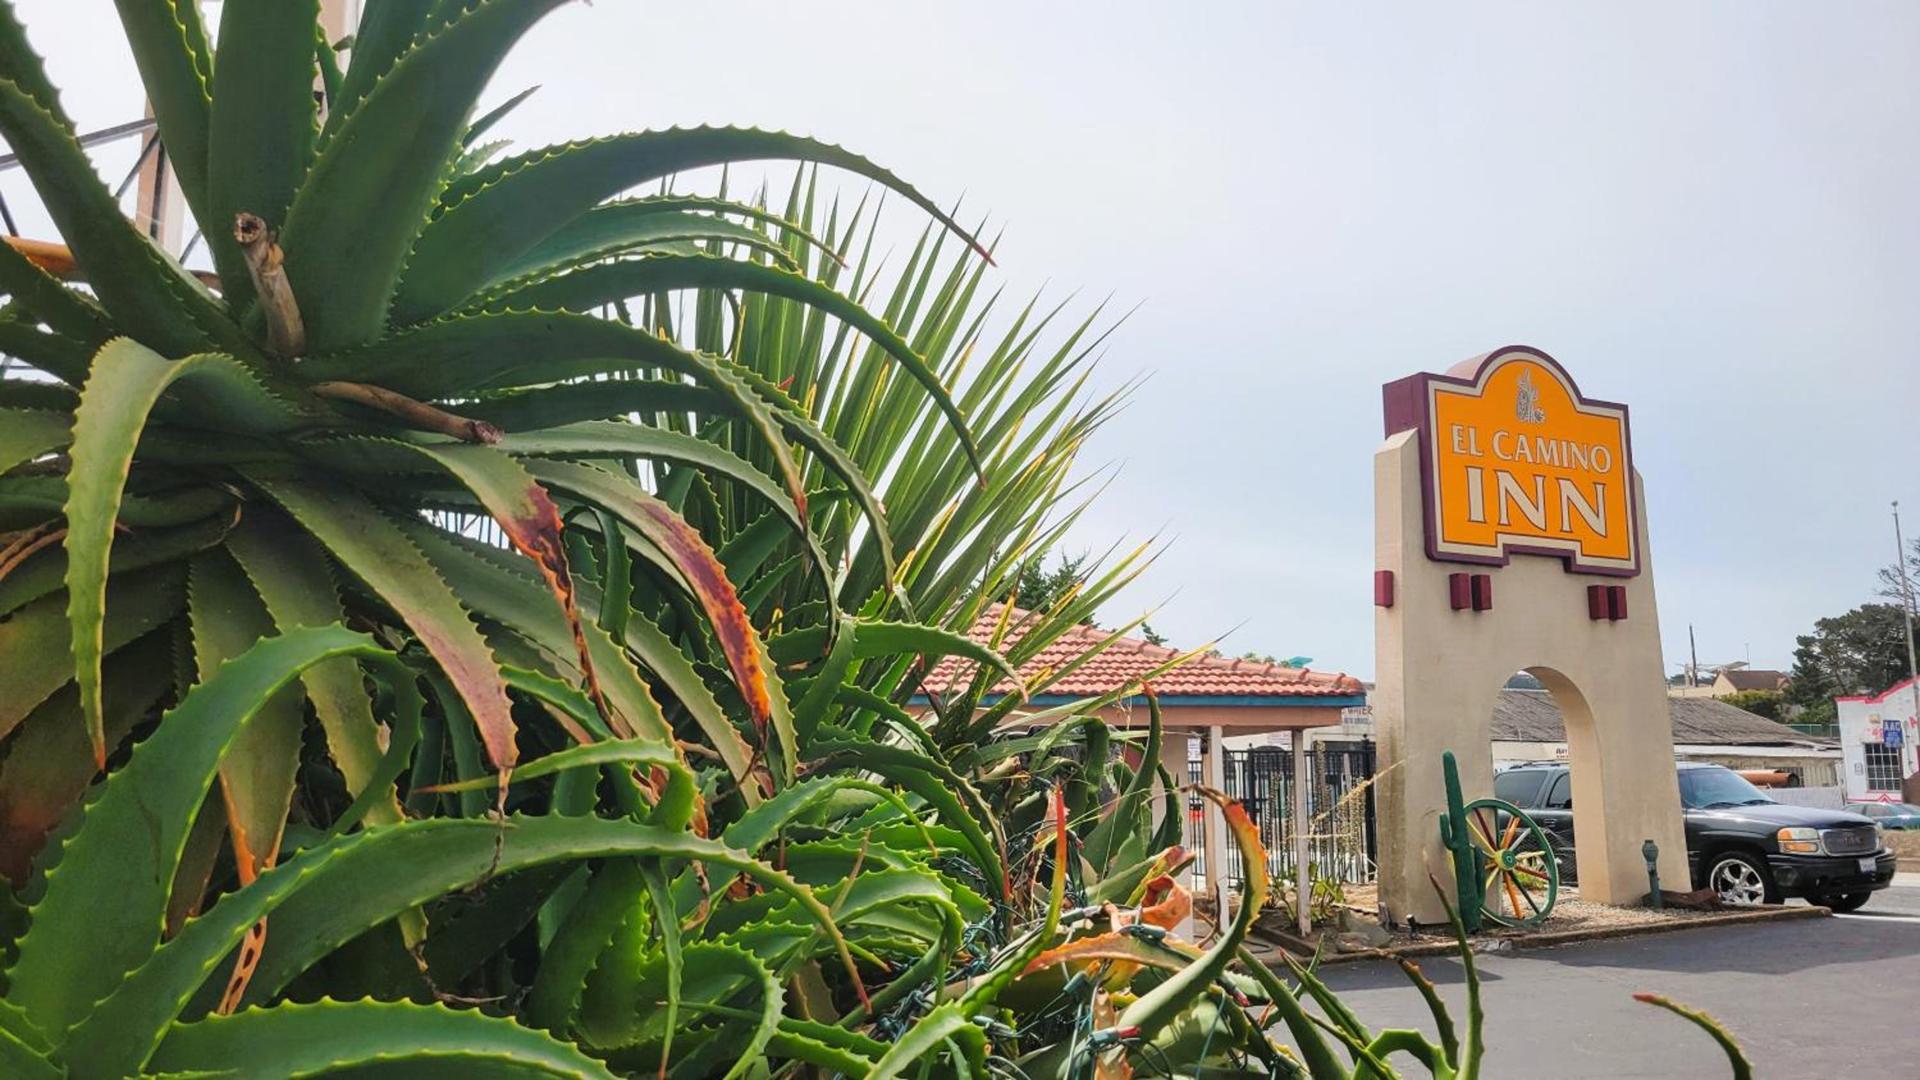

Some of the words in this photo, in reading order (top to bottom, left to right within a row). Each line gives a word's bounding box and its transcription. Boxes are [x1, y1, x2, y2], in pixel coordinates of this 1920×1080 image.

[1451, 423, 1484, 457] EL
[1492, 430, 1612, 474] CAMINO
[1465, 465, 1607, 538] INN
